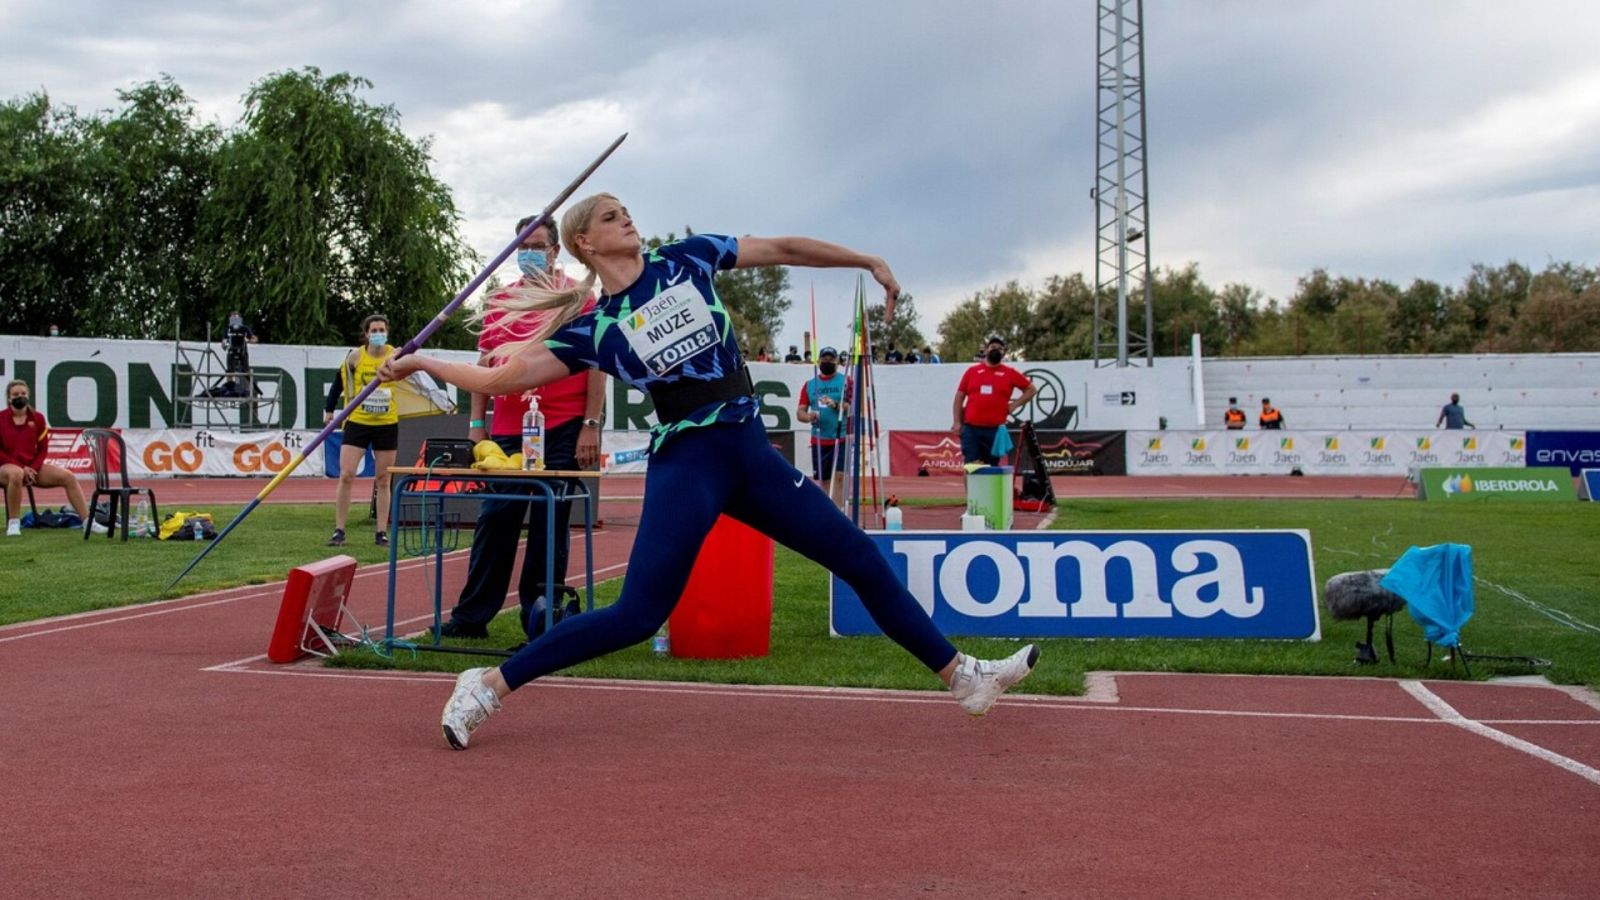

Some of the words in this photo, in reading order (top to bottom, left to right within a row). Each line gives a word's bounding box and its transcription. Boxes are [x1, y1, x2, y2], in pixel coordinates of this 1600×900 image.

[646, 308, 695, 344] MUZE
[0, 350, 193, 429] IÓN
[143, 441, 203, 472] GO
[195, 432, 215, 448] fit
[232, 442, 291, 472] GO
[284, 432, 303, 448] fit
[1474, 479, 1559, 491] IBERDROLA
[893, 539, 1265, 618] Joma
